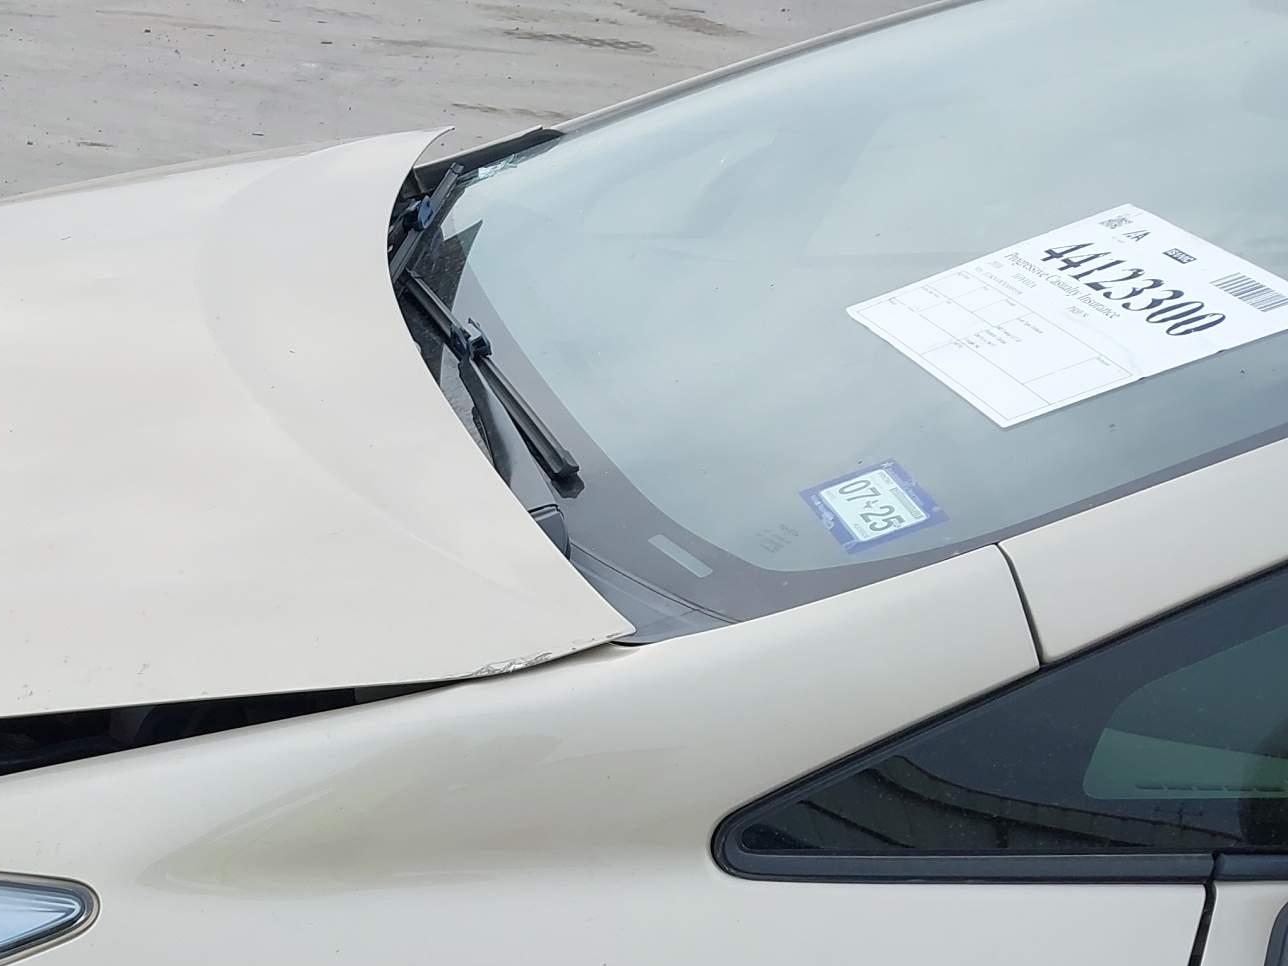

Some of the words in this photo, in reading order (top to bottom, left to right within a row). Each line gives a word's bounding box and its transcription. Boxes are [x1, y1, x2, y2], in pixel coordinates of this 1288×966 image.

[1040, 242, 1226, 337] 44123300
[1077, 293, 1121, 320] Insurance
[838, 479, 881, 502] 07
[859, 504, 906, 532] 25
